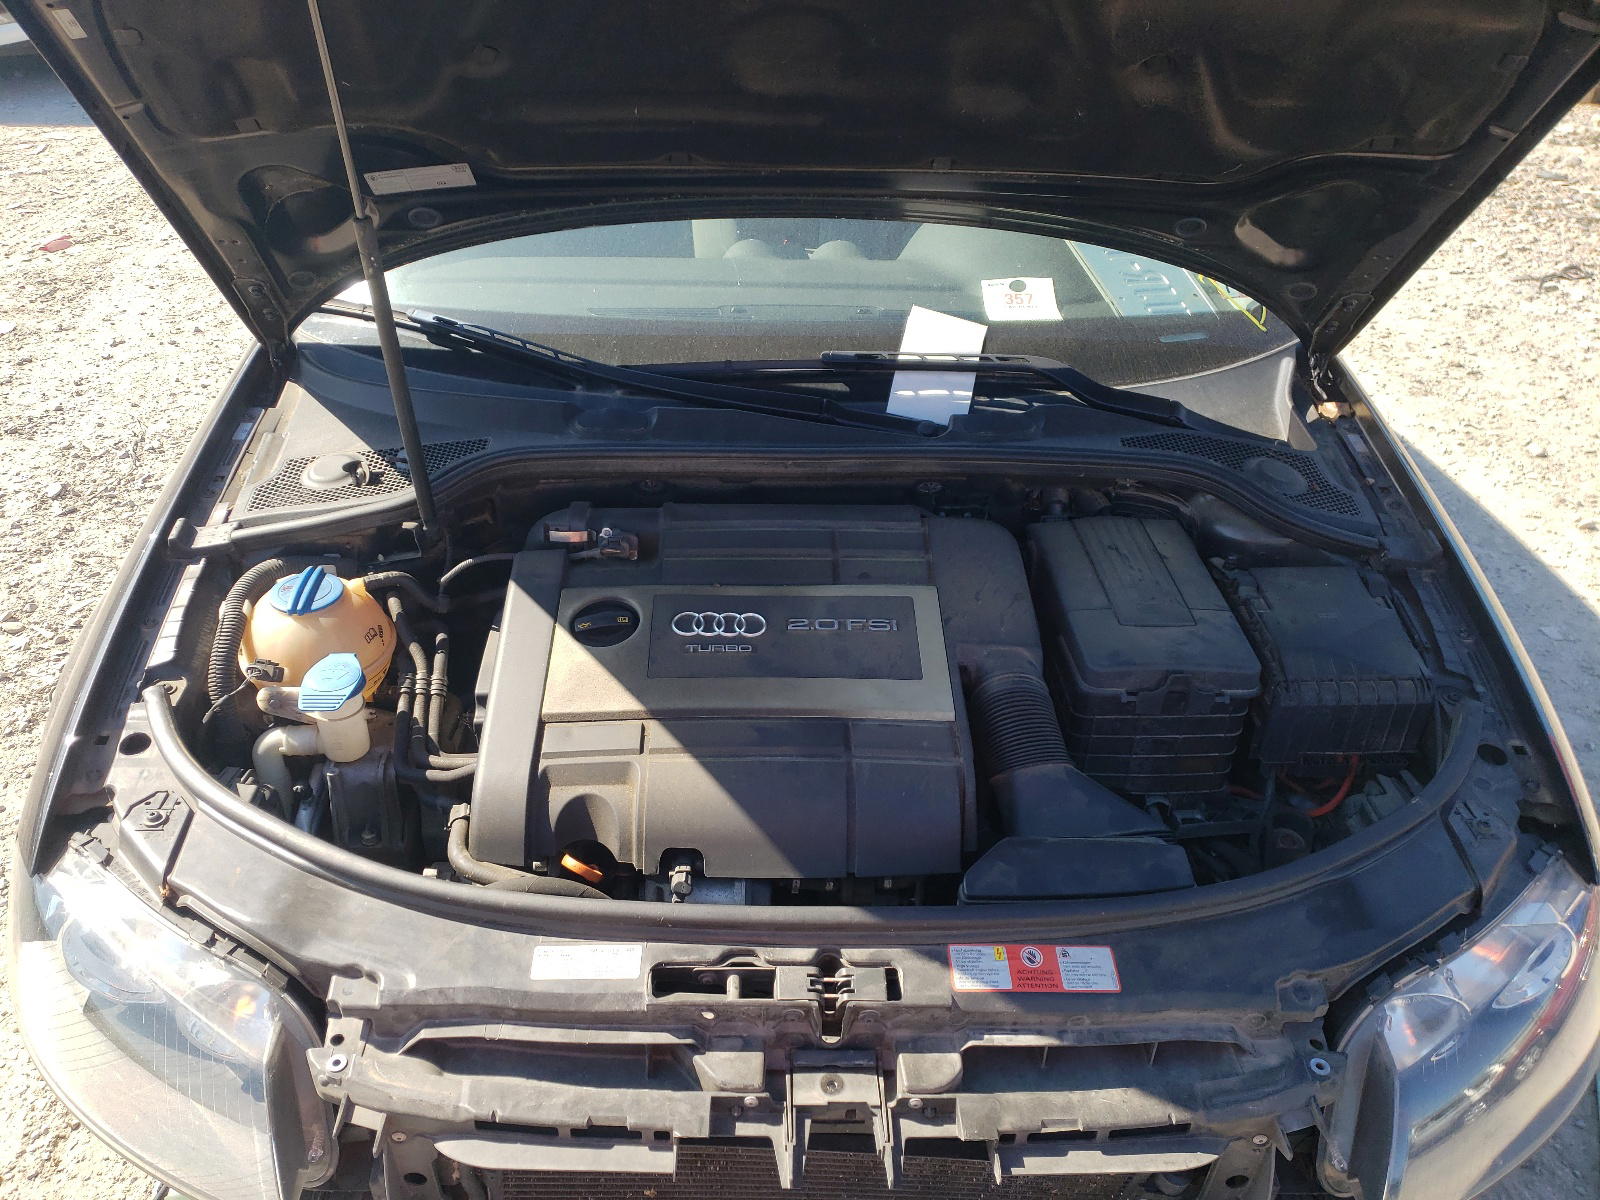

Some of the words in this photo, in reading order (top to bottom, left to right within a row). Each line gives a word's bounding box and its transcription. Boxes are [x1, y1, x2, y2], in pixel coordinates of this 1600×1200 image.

[1004, 293, 1033, 305] 357
[787, 618, 839, 631] 2.0
[685, 644, 753, 652] TURBO
